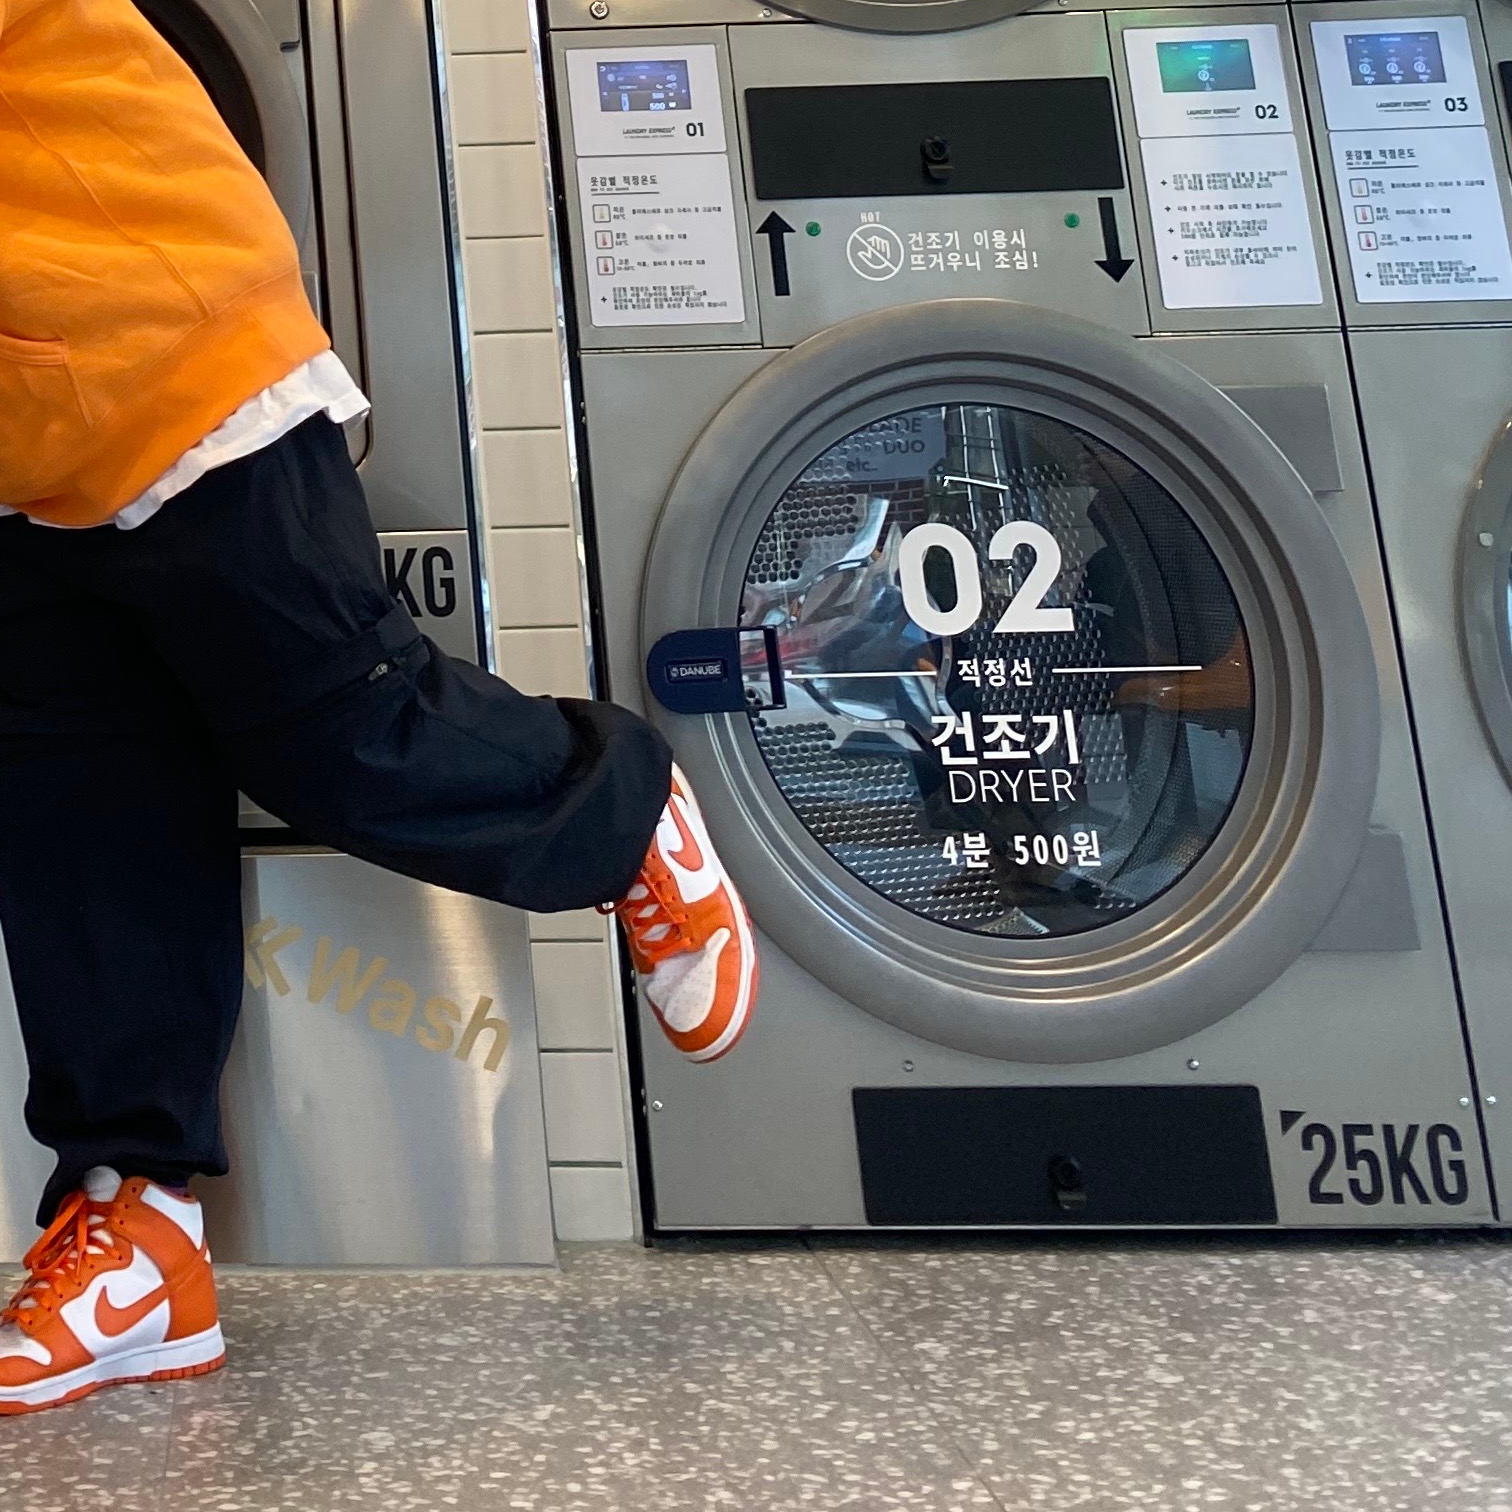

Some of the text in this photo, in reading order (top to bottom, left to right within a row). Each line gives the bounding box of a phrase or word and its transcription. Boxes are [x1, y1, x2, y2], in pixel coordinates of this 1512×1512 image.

[1255, 104, 1279, 119] 02
[1444, 97, 1468, 112] 03
[686, 122, 705, 137] 01
[860, 212, 880, 223] HOT
[907, 228, 1026, 251] 건조기 이용시
[910, 250, 1039, 271] 뜨거우니 조심!
[898, 519, 1074, 636] 02
[679, 665, 721, 676] DANUBE
[957, 656, 1034, 688] 적정선
[931, 709, 1080, 766] 건조기
[949, 769, 1076, 803] DRYER
[941, 829, 1102, 868] 4분 500원
[305, 932, 511, 1073] Wash
[1303, 1121, 1466, 1205] 25KG
